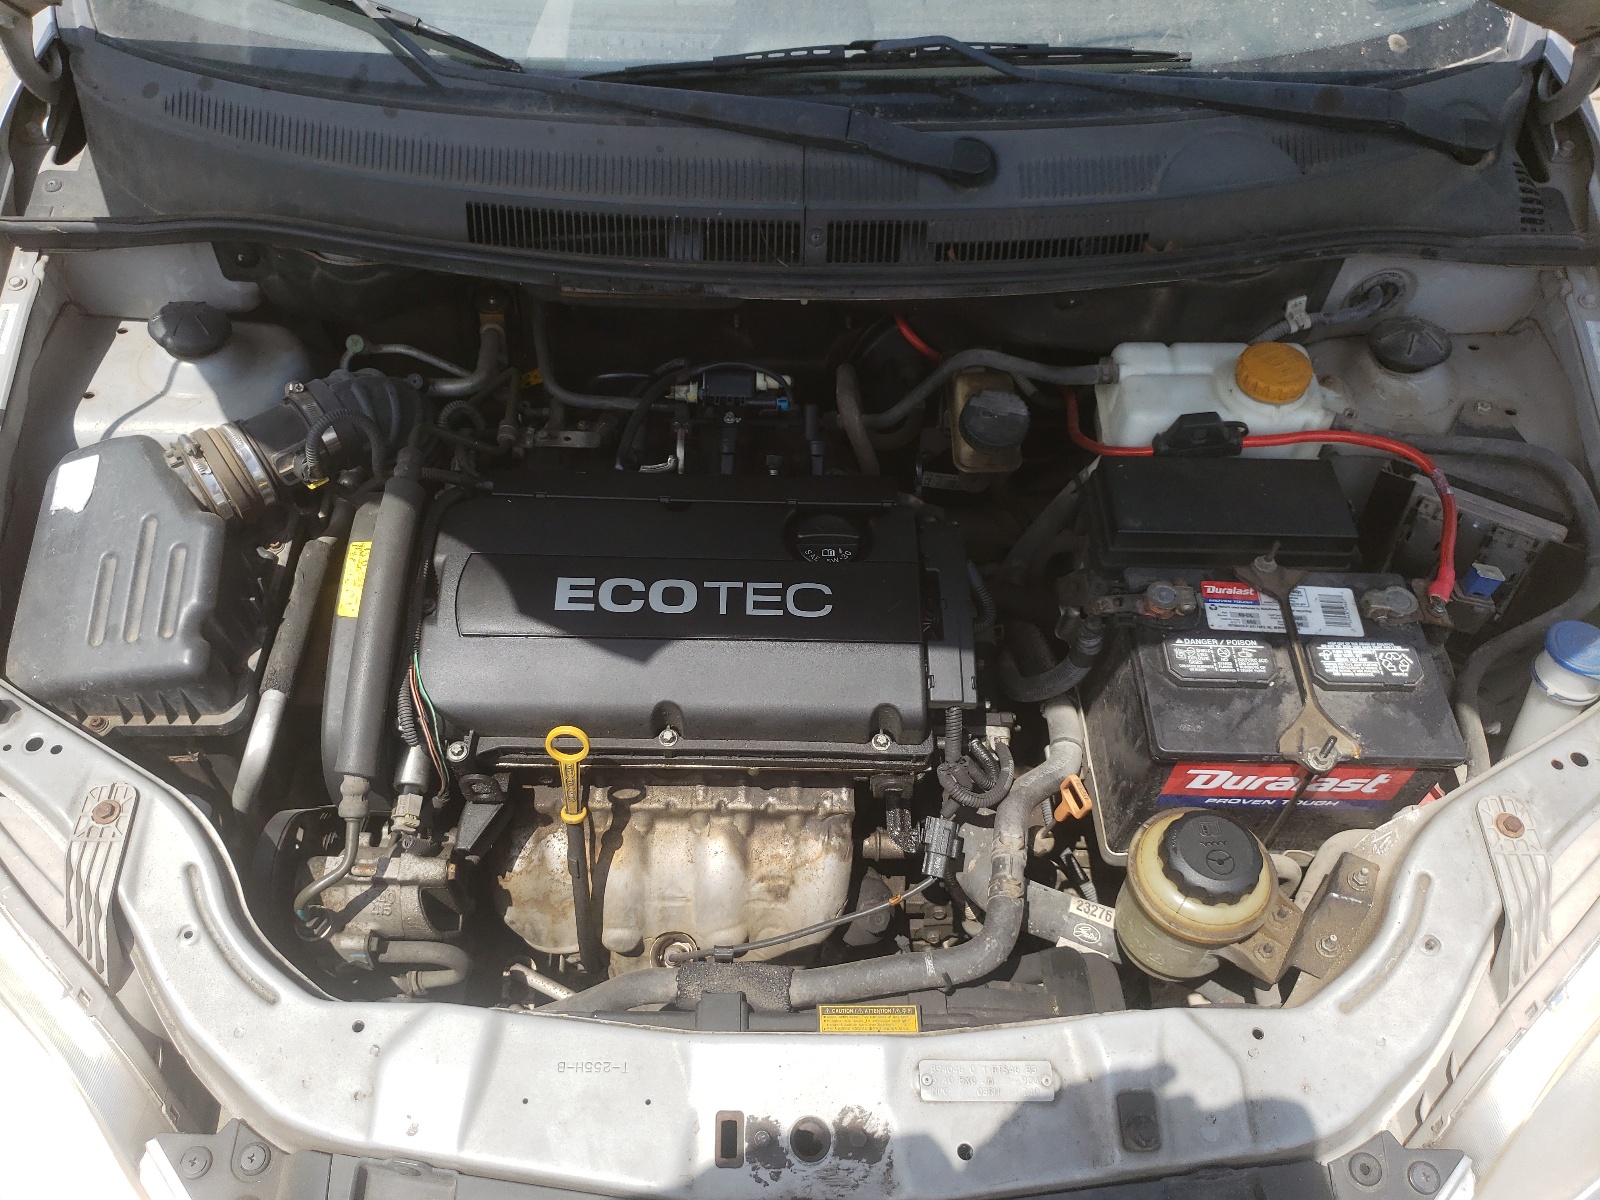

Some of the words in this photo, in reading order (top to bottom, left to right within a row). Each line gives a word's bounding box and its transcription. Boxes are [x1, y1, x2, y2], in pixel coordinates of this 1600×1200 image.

[554, 576, 833, 618] ECOTEC
[1203, 585, 1255, 596] Duralast
[1204, 798, 1277, 806] PROVEN
[1076, 899, 1113, 923] 23276
[557, 1061, 628, 1074] T-255H-B
